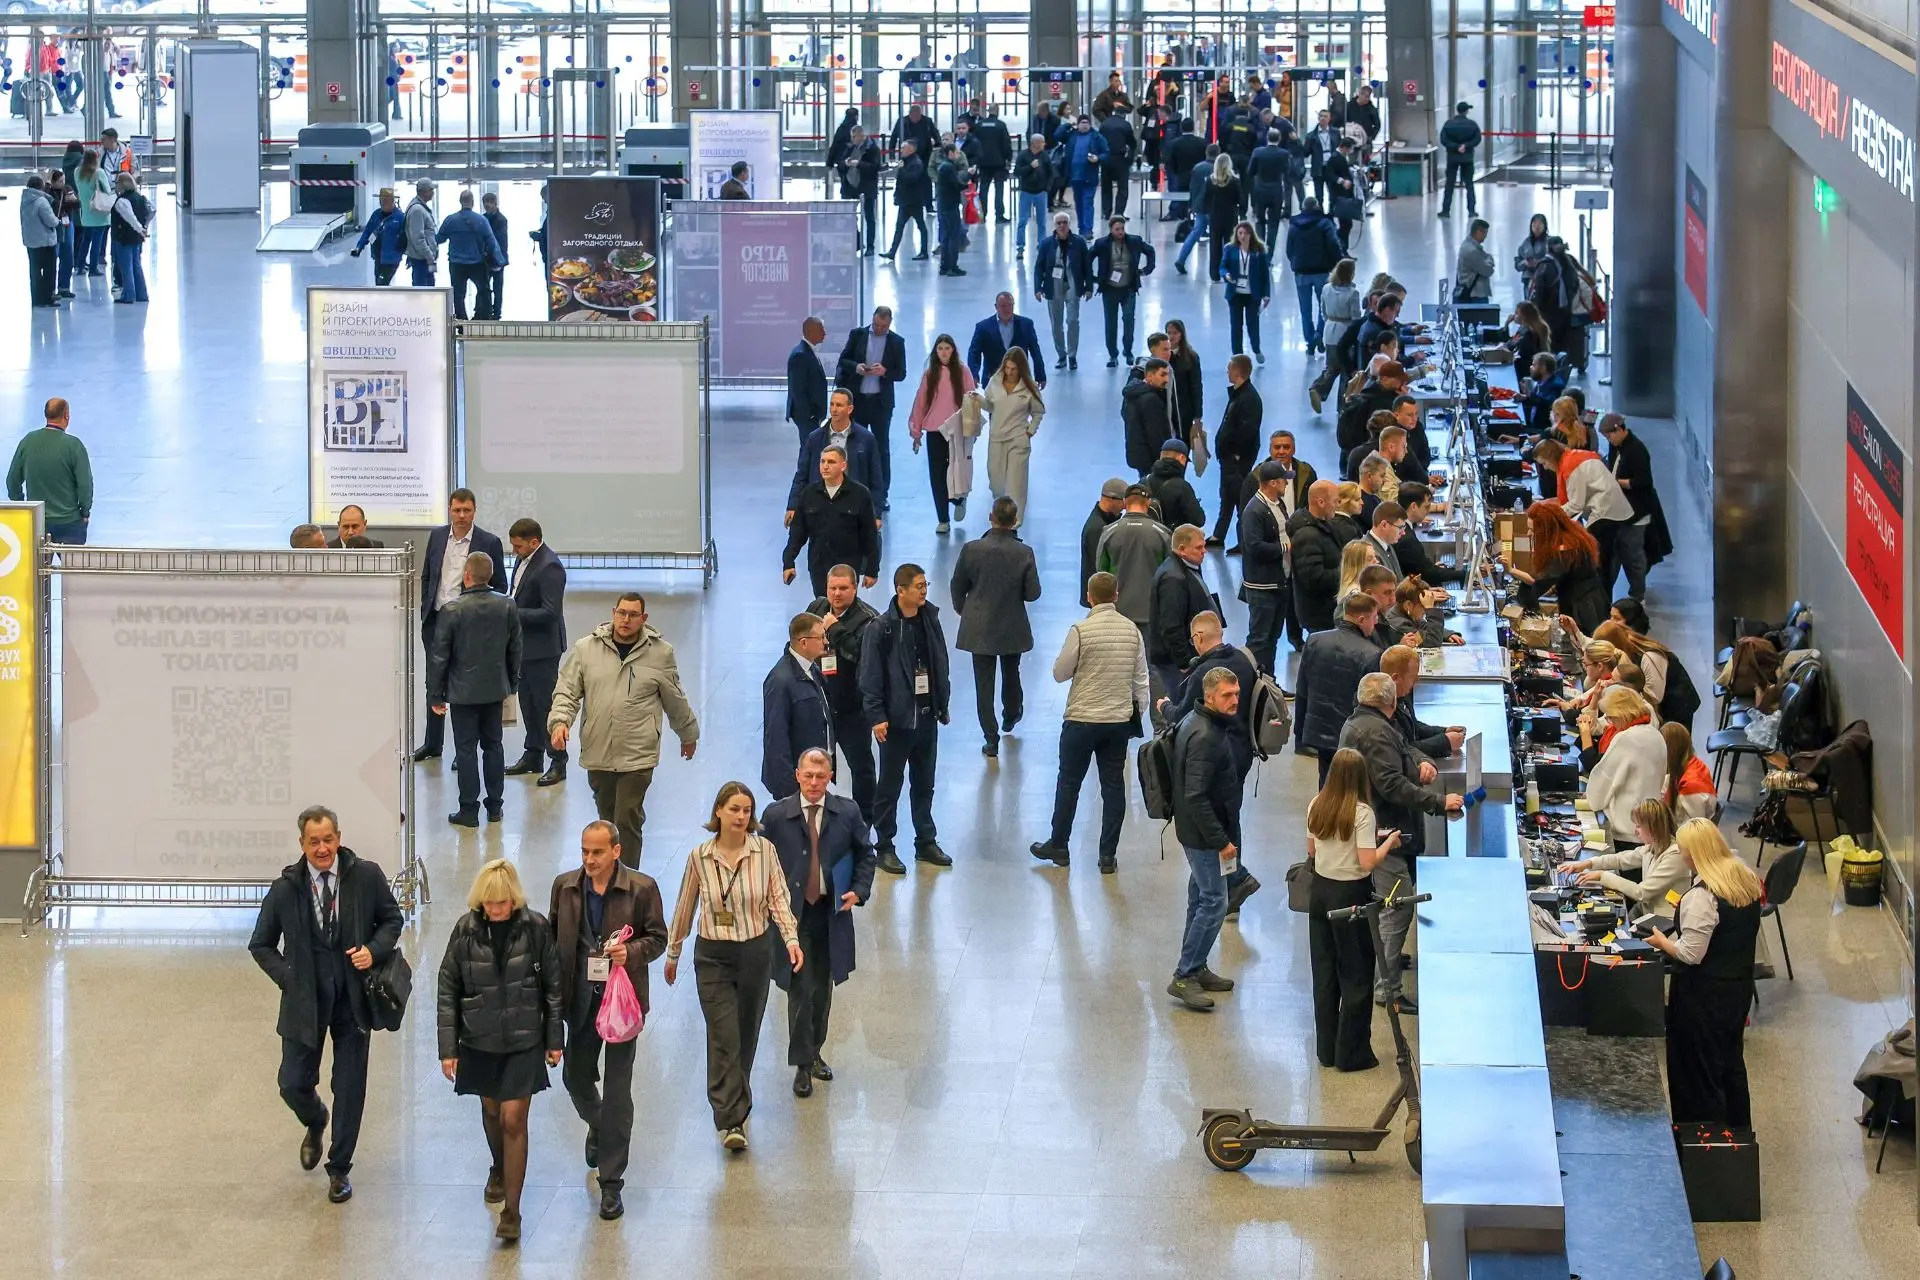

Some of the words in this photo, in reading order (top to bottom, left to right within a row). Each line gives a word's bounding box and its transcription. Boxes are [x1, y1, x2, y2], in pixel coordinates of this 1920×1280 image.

[1772, 40, 1840, 139] РЕГИСТРАЦИЯ
[1852, 97, 1916, 203] REGISTRA
[322, 303, 368, 313] ДИЗАЙН
[322, 317, 331, 326] И
[333, 317, 431, 327] ПРОЕКТИРОВАНИЕ
[322, 328, 377, 337] ВЫСТАВОЧНЫХ
[378, 328, 432, 338] ЭКСПОЗИЦИЙ
[332, 347, 397, 356] BUILDEXPO
[1854, 472, 1895, 556] РЕГИСТРАЦИЯ
[0, 667, 20, 680] АХ!
